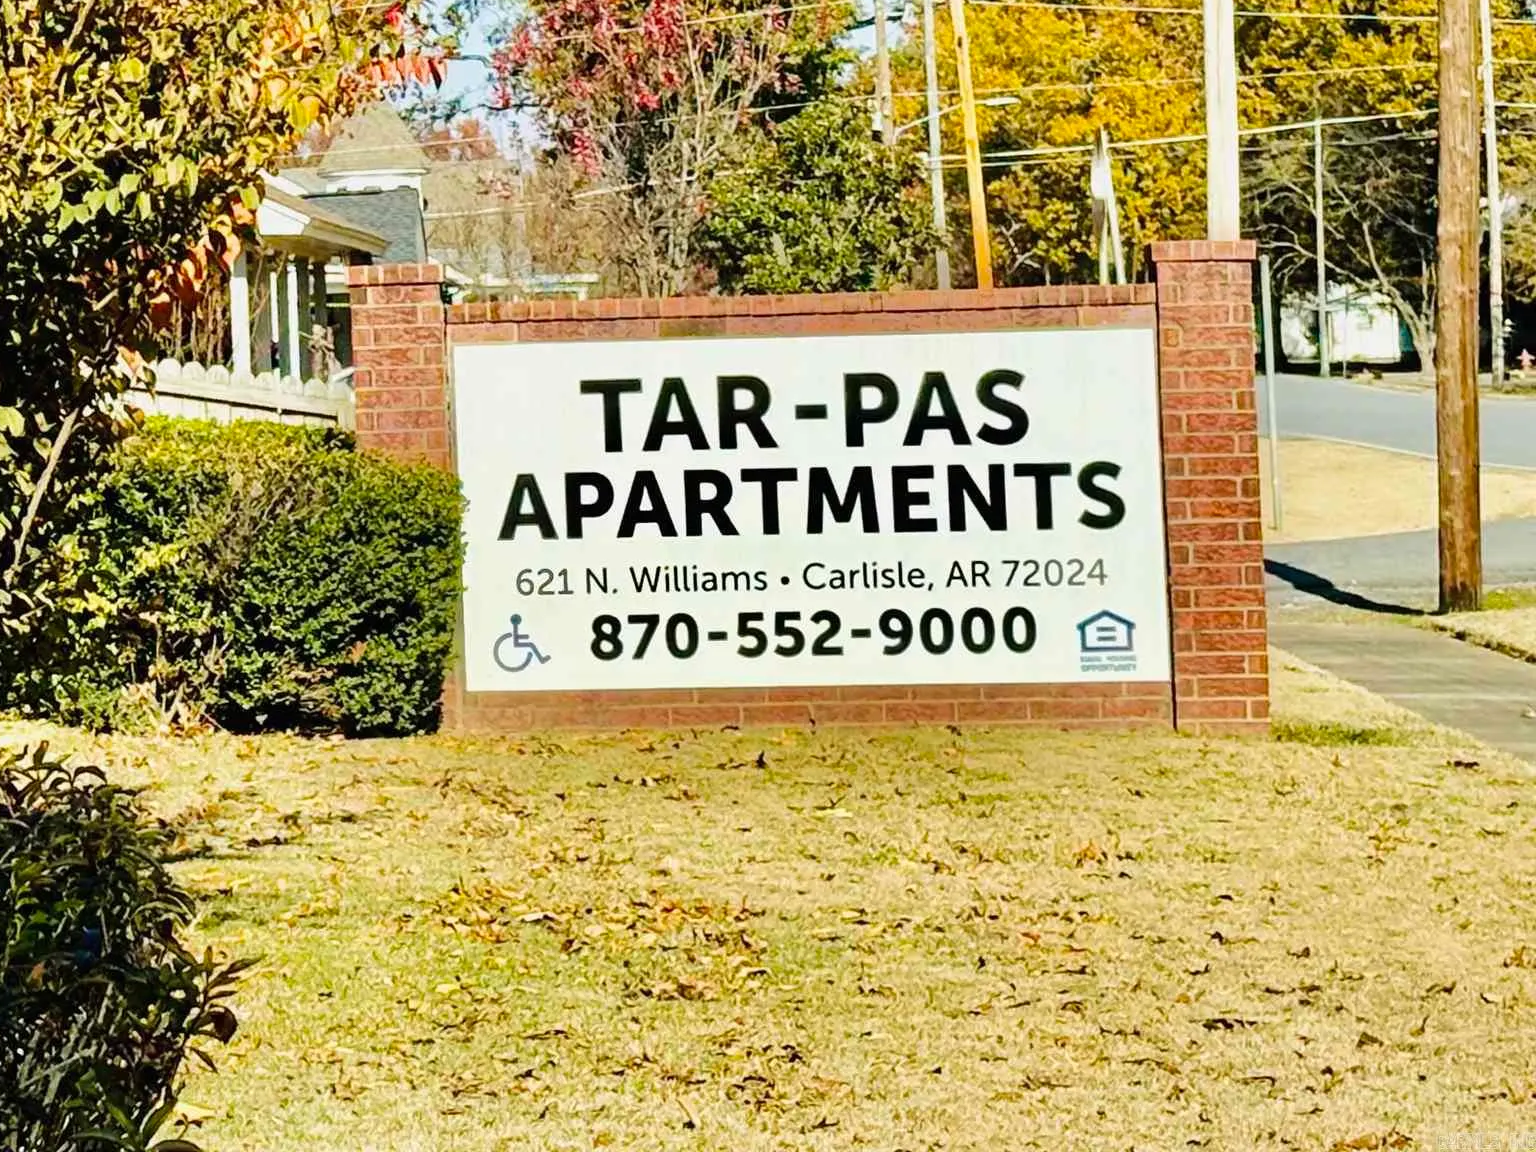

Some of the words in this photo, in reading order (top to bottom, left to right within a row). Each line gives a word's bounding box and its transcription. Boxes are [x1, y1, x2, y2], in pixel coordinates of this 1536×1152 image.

[579, 368, 1030, 454] TAR-PAS
[496, 460, 1127, 542] APARTMENTS
[515, 568, 575, 597] 621
[585, 567, 618, 595] N.
[628, 564, 768, 593] Williams
[802, 560, 934, 592] Carlisle,
[945, 560, 992, 588] AR
[1001, 558, 1109, 587] 72024
[590, 605, 1038, 662] 870-552-9000
